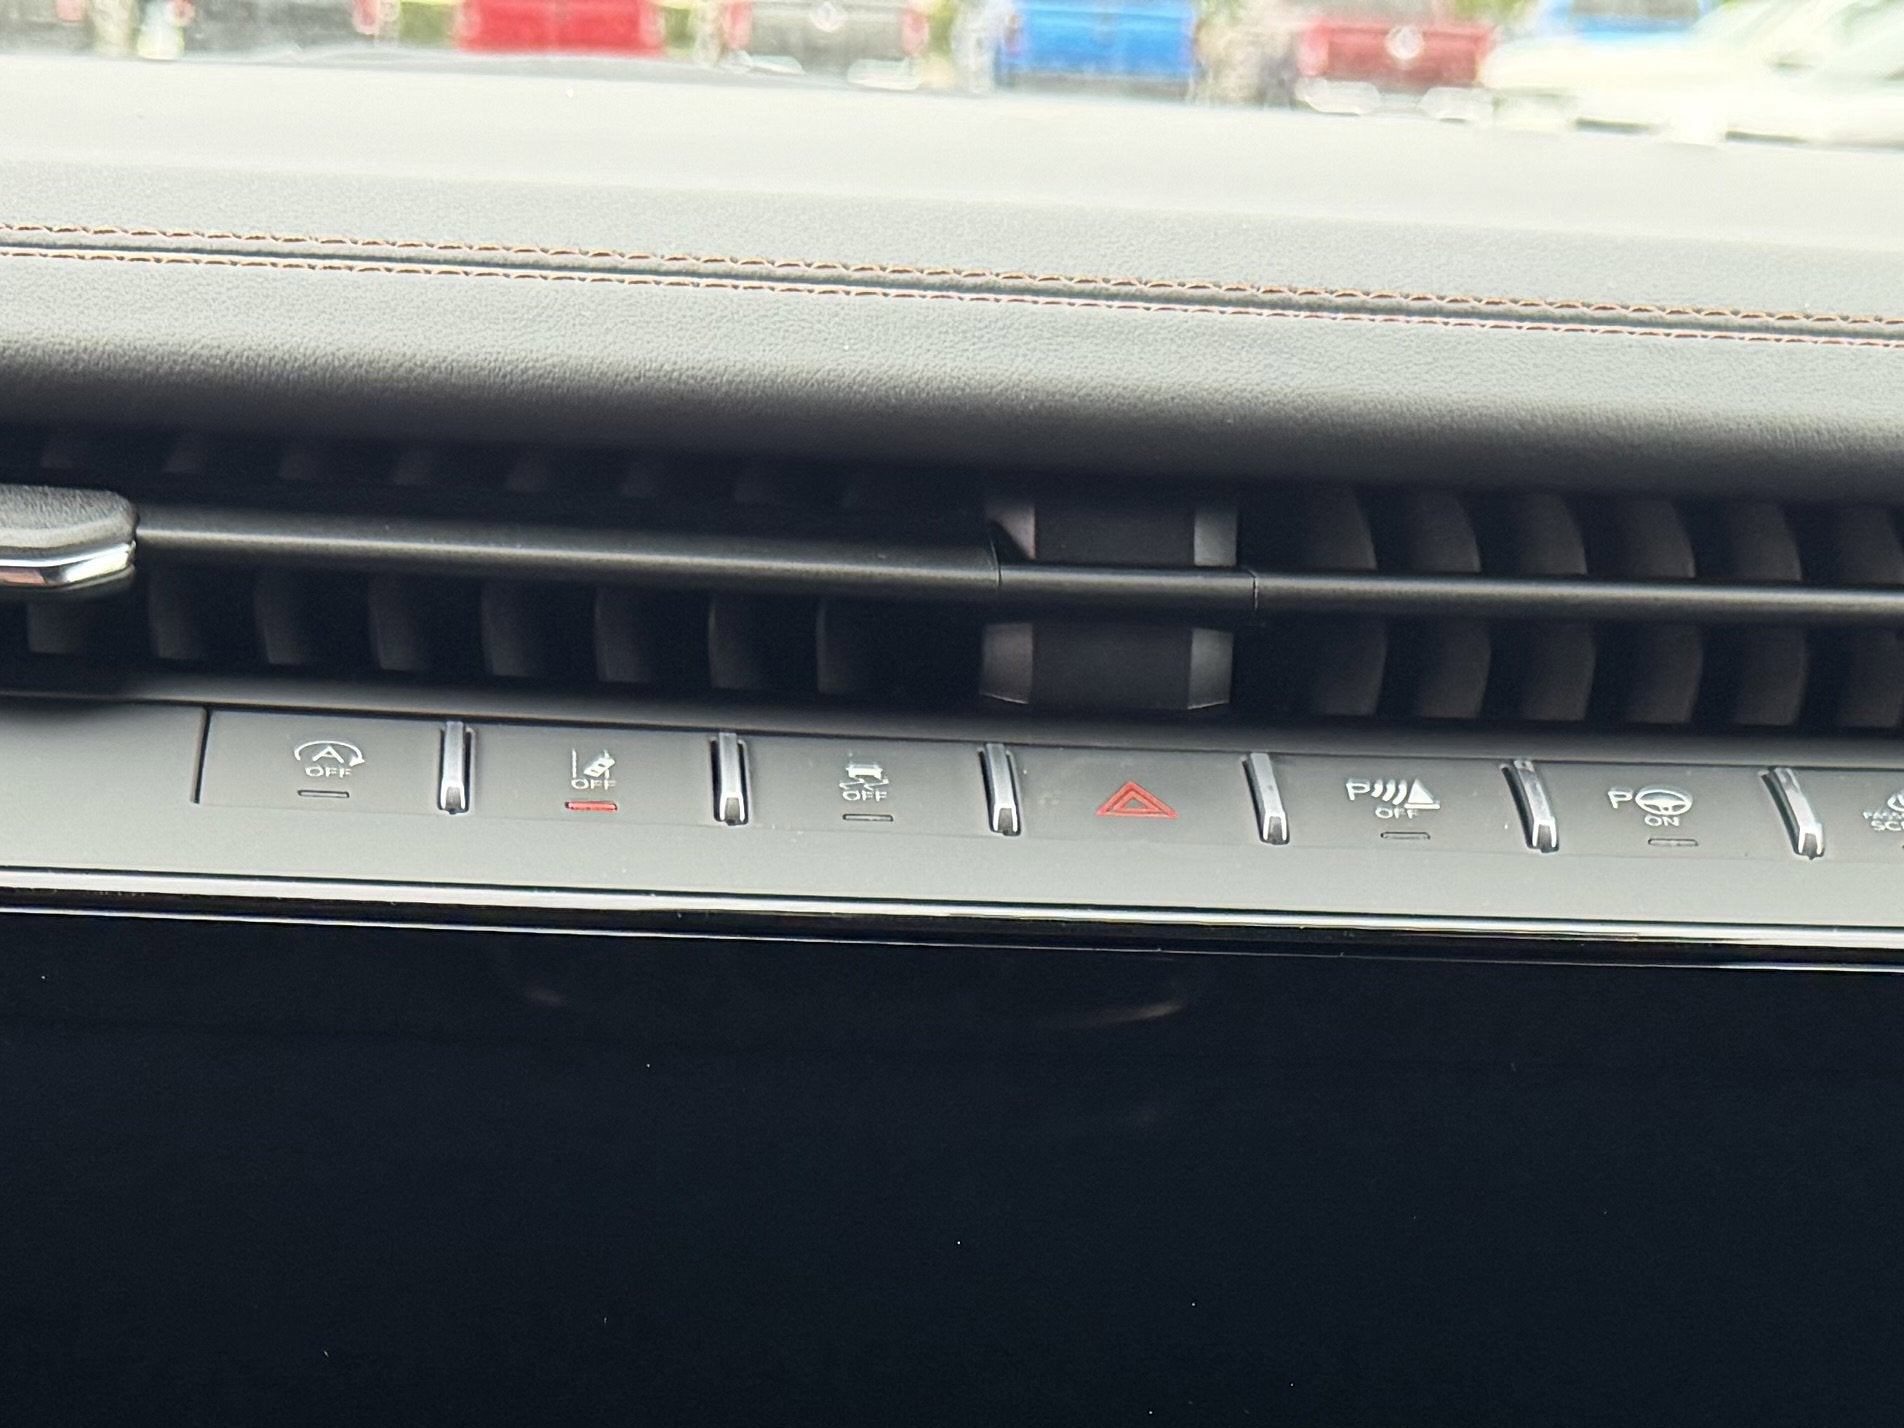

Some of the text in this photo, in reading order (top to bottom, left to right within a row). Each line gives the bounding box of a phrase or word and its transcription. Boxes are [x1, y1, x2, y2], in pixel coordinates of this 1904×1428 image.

[304, 766, 352, 778] OFF
[571, 779, 616, 790] OFF
[842, 789, 887, 801] OFF
[1375, 806, 1418, 819] OFF
[1644, 814, 1680, 827] ON
